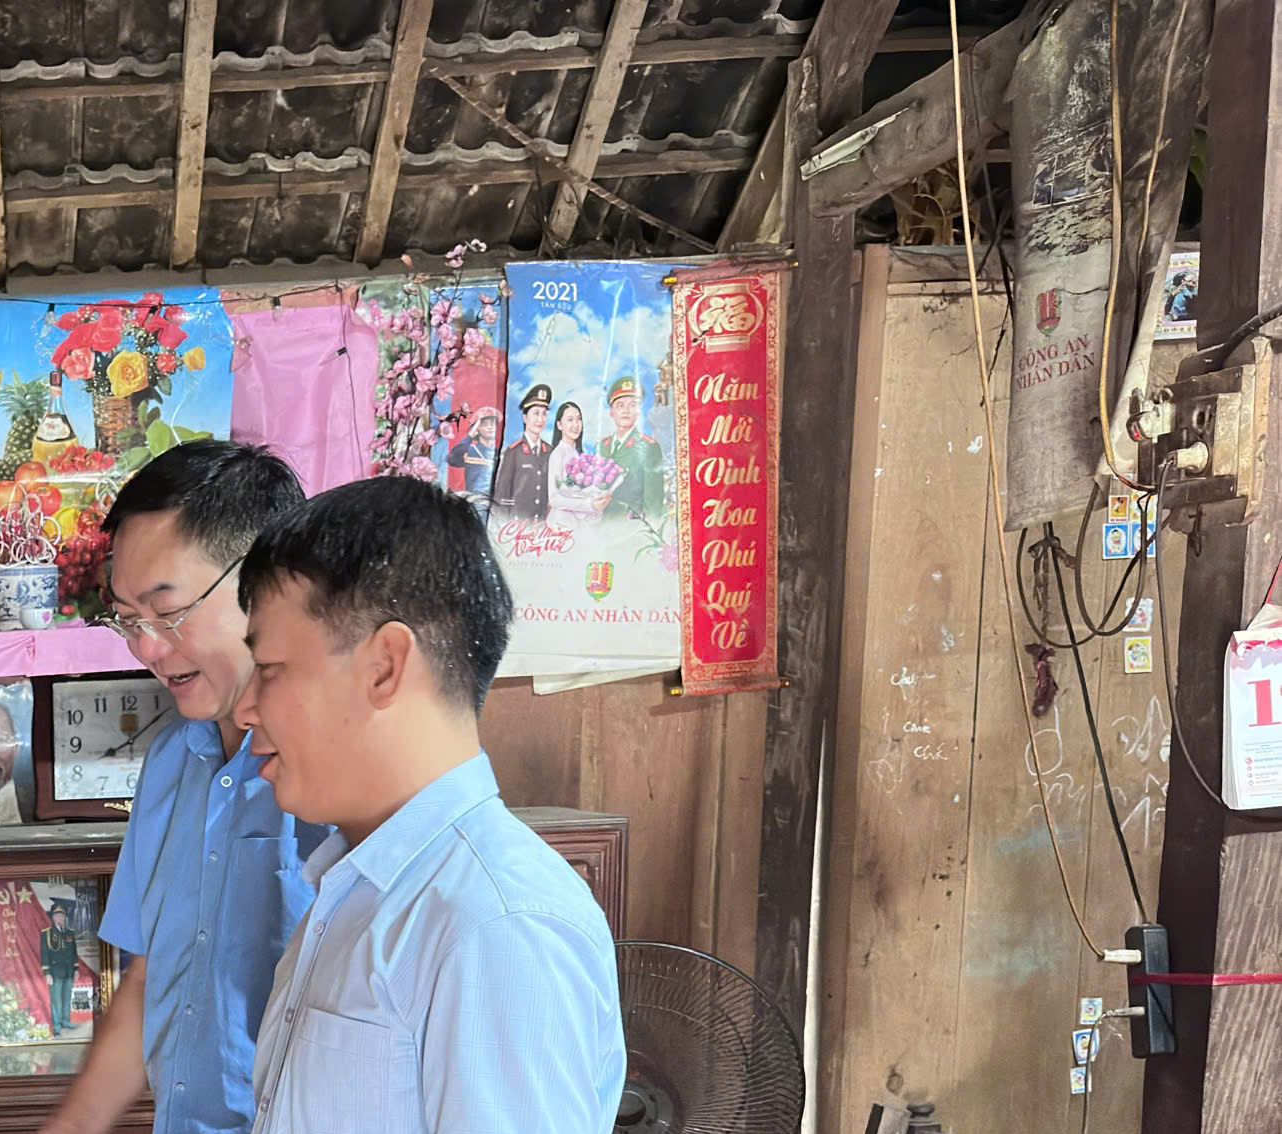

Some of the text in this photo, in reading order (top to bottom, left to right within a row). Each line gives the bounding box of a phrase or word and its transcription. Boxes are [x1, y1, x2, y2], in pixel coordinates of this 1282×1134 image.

[532, 281, 578, 302] 2021
[699, 296, 756, 334] 福
[1019, 333, 1093, 372] CÔNG AN
[1058, 351, 1095, 376] DÂN
[694, 372, 761, 405] Năm
[701, 414, 754, 446] Mới
[695, 456, 761, 487] Vinh
[702, 498, 758, 529] Hoa
[702, 539, 757, 576] Phú
[512, 602, 559, 624] CÔNG
[563, 608, 589, 623] AN
[592, 605, 643, 624] NHÂN
[706, 580, 752, 617] Quý
[710, 617, 750, 650] Về
[67, 709, 84, 726] 10
[93, 695, 159, 713] 11 12 1
[1247, 679, 1282, 728] 1
[69, 736, 82, 754] 9
[71, 764, 84, 782] 8
[96, 771, 137, 791] 7 6
